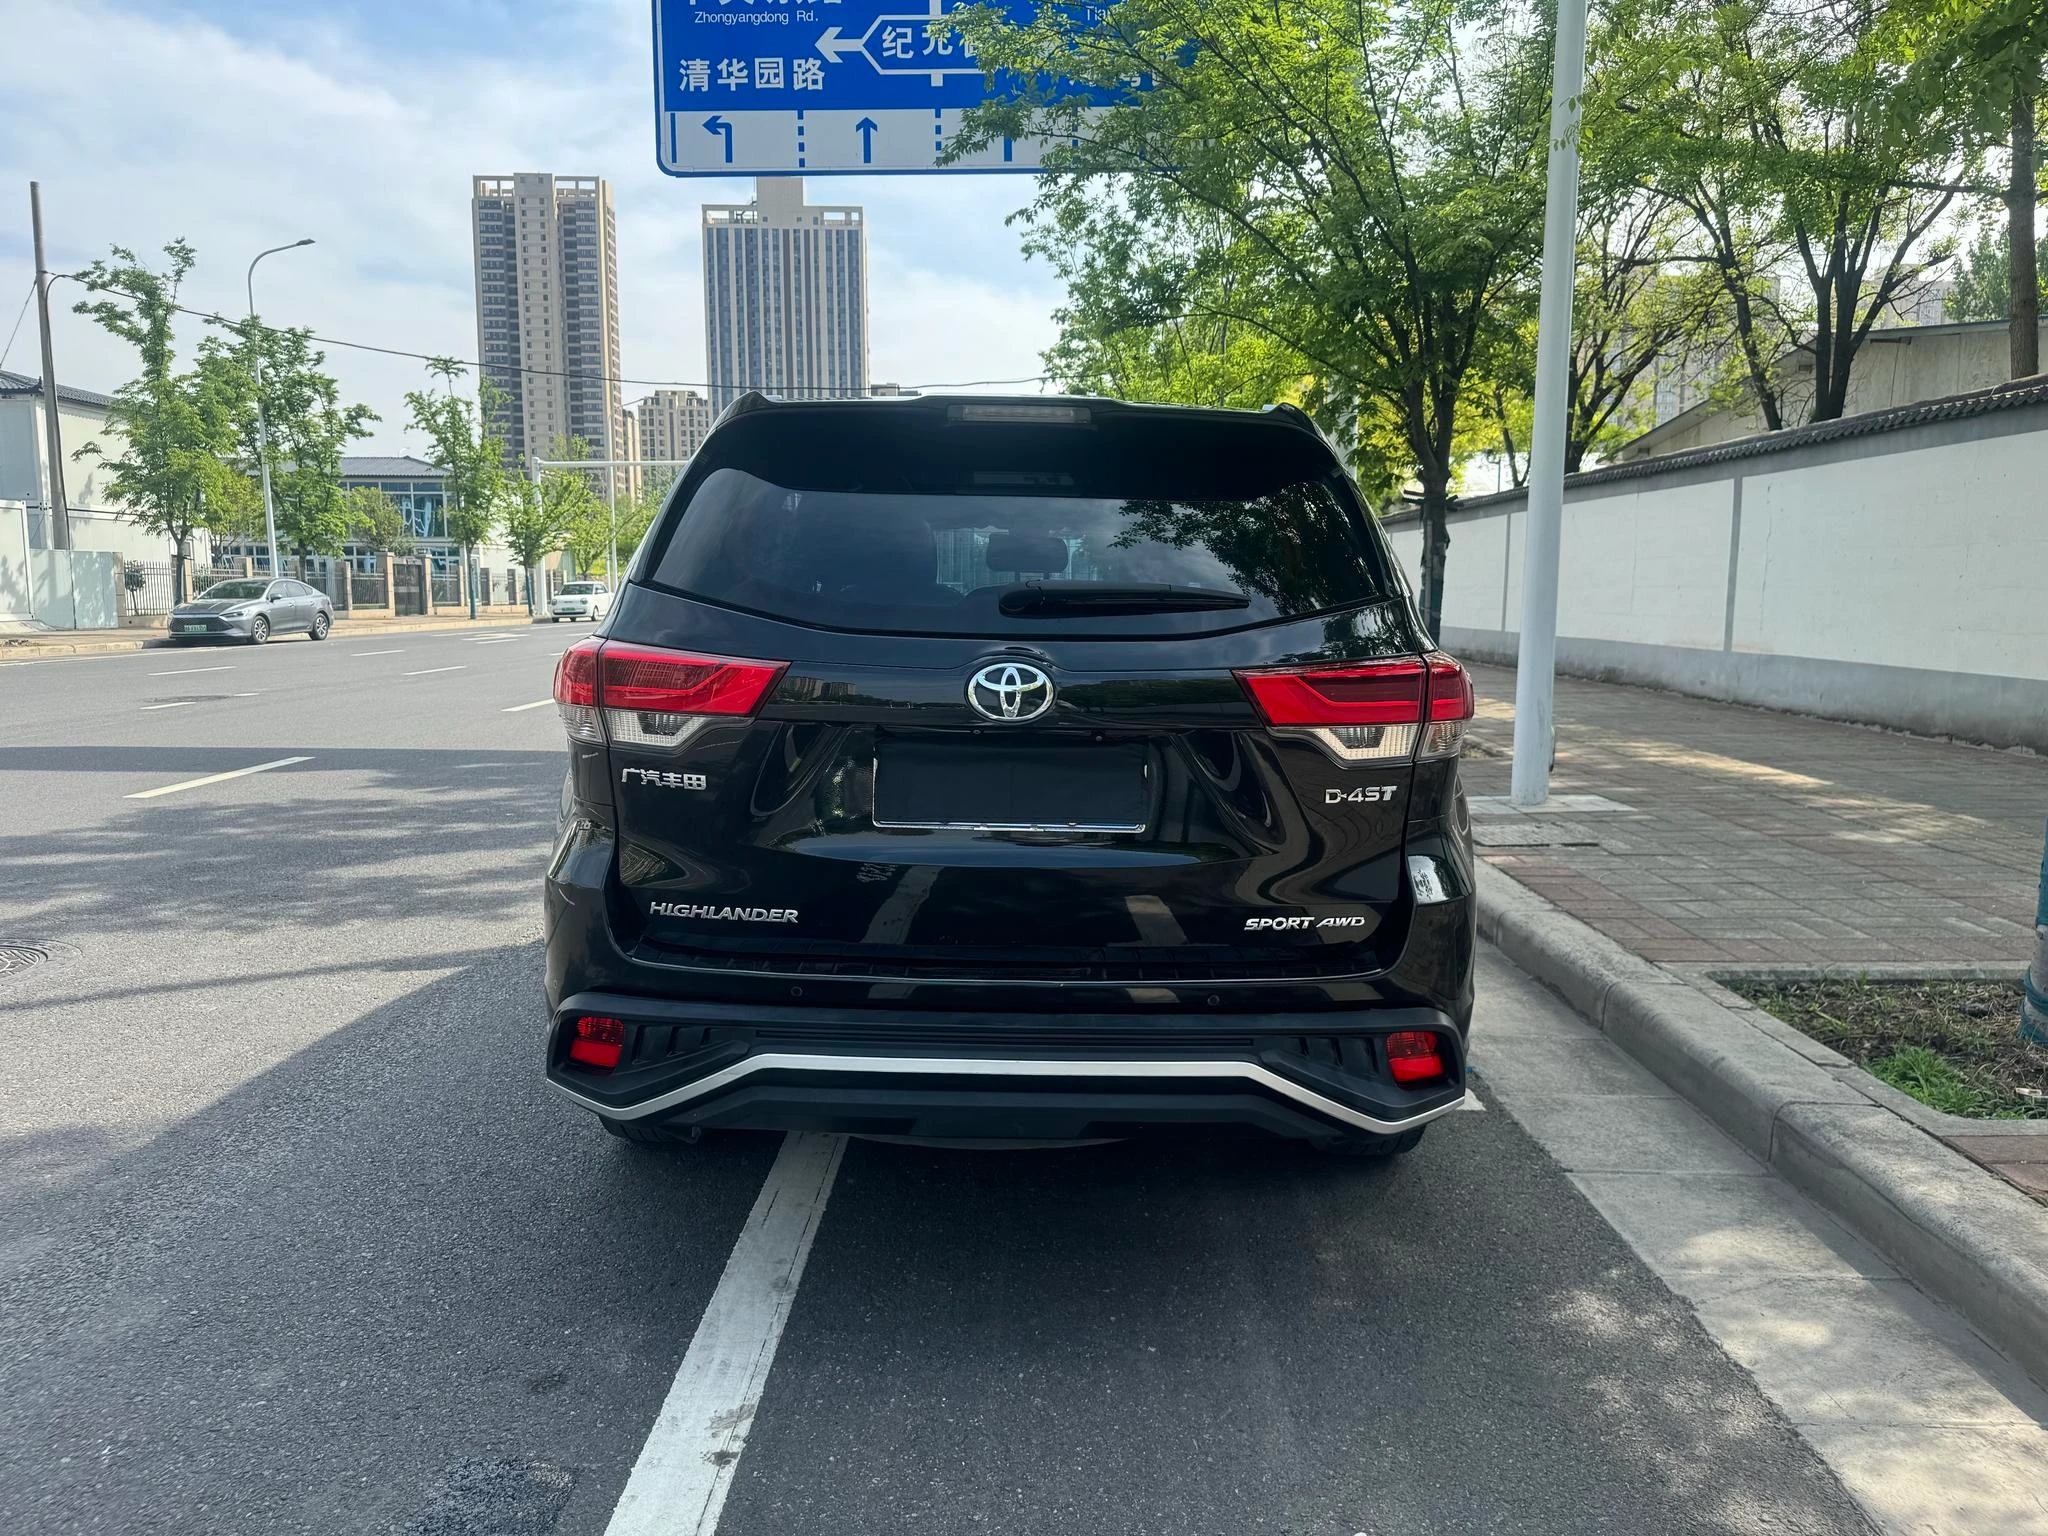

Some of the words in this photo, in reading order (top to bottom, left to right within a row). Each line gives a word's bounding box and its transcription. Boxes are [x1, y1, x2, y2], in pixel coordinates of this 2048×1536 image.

[694, 11, 789, 26] Zhongyangdong
[796, 10, 819, 22] Rd.
[679, 57, 825, 92] 清华园路
[621, 768, 707, 790] 广汽丰田
[650, 901, 799, 924] HIGHLANDER
[1244, 916, 1316, 931] SPORT
[1315, 916, 1366, 928] AWD
